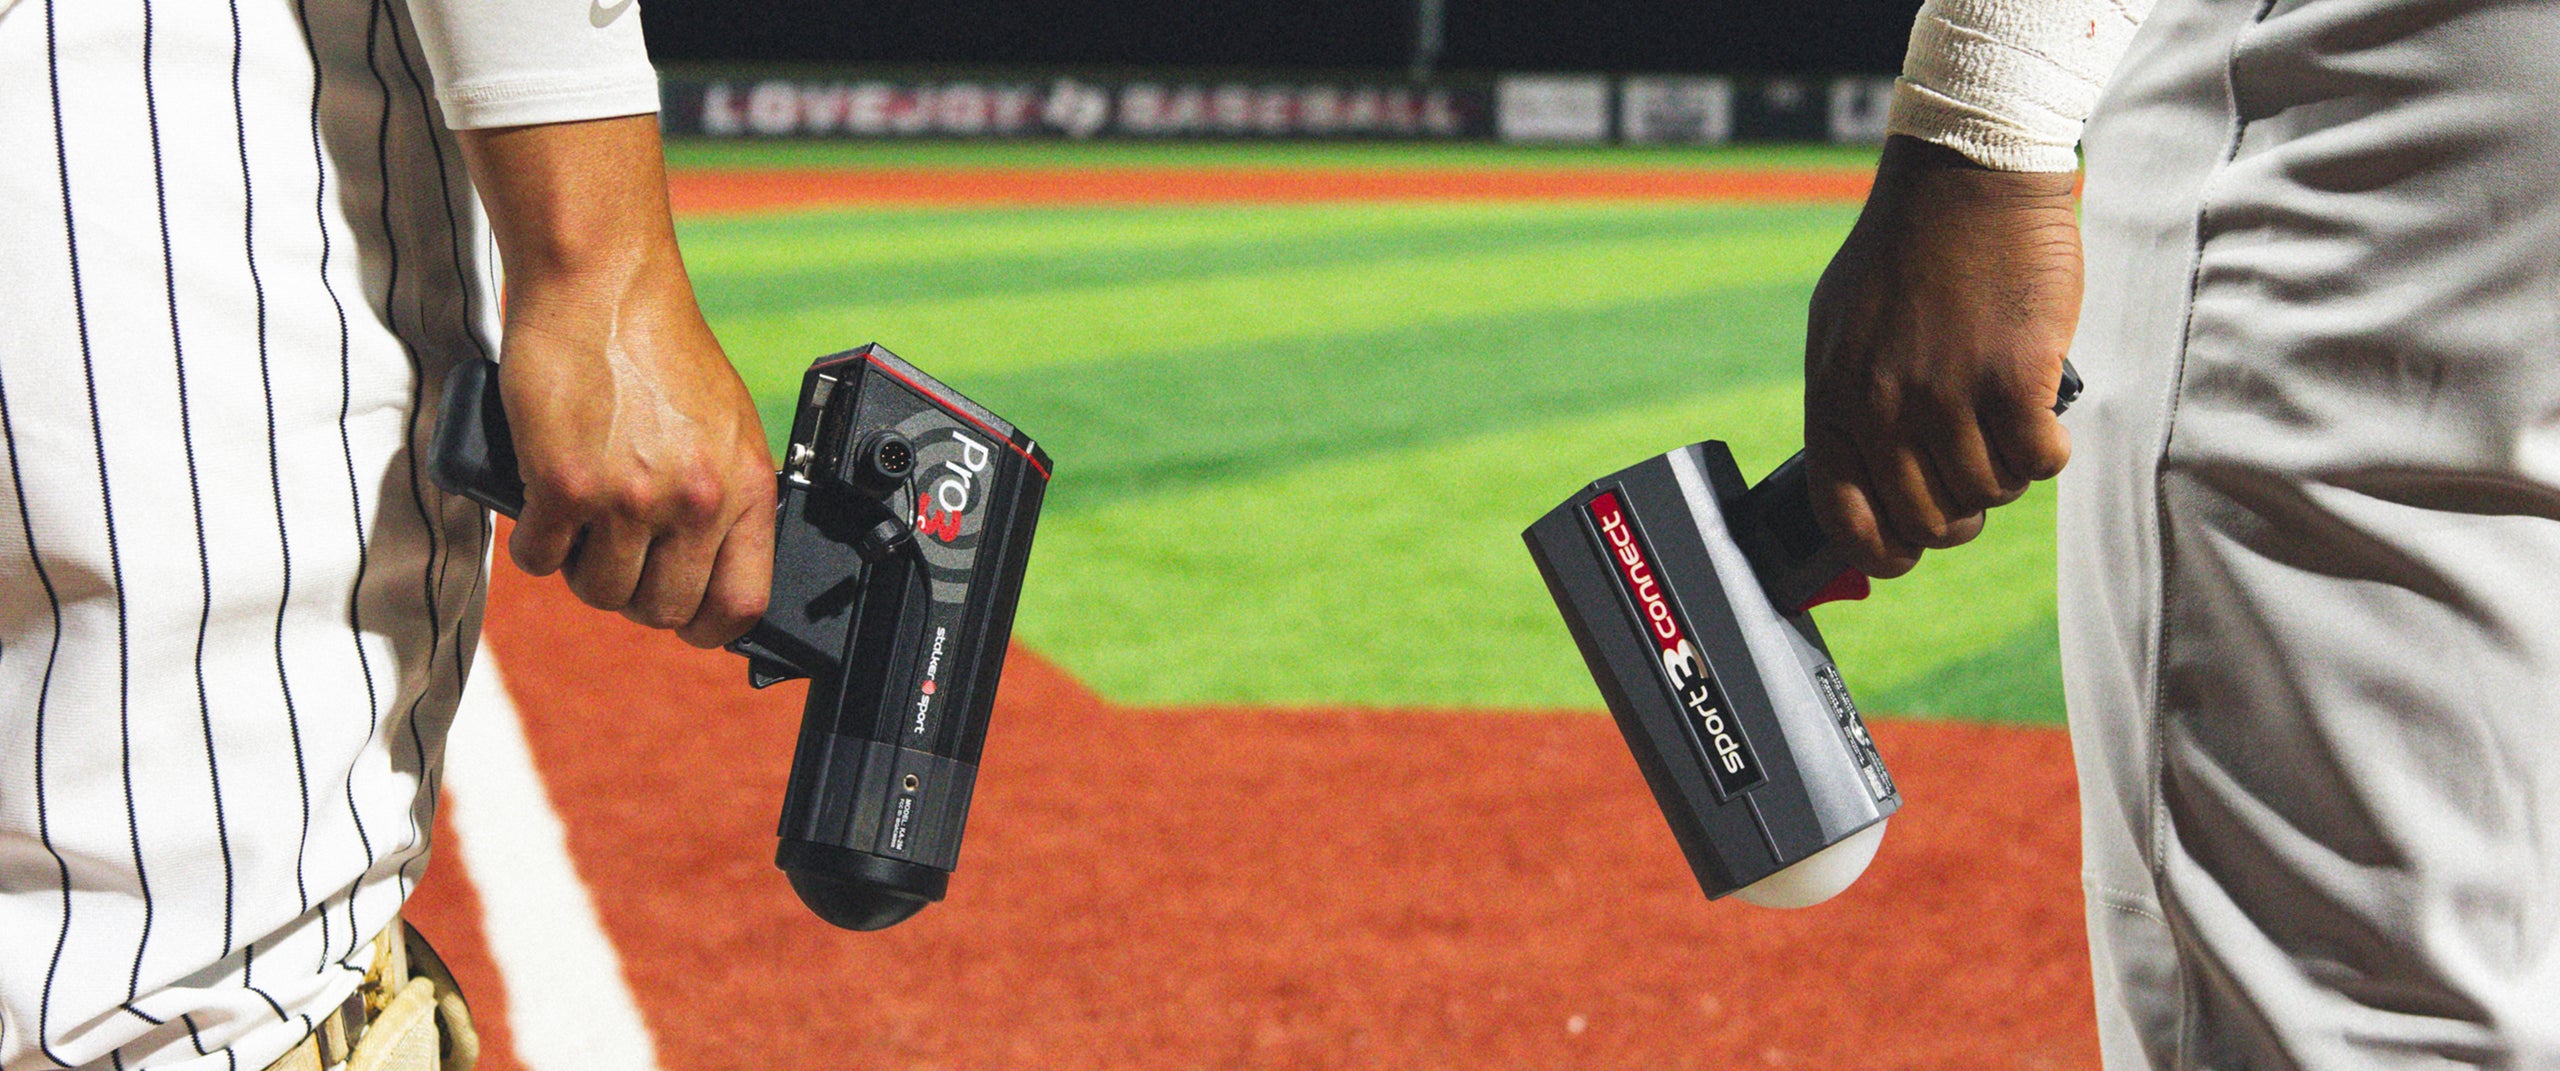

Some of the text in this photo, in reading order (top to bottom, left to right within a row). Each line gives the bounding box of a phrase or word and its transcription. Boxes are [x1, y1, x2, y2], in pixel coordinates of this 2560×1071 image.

[703, 83, 1038, 133] LOVEJOY
[1120, 84, 1461, 133] BASEBALL
[1602, 510, 1676, 638] connect
[914, 626, 945, 734] stalker sport
[1689, 685, 1745, 774] sport
